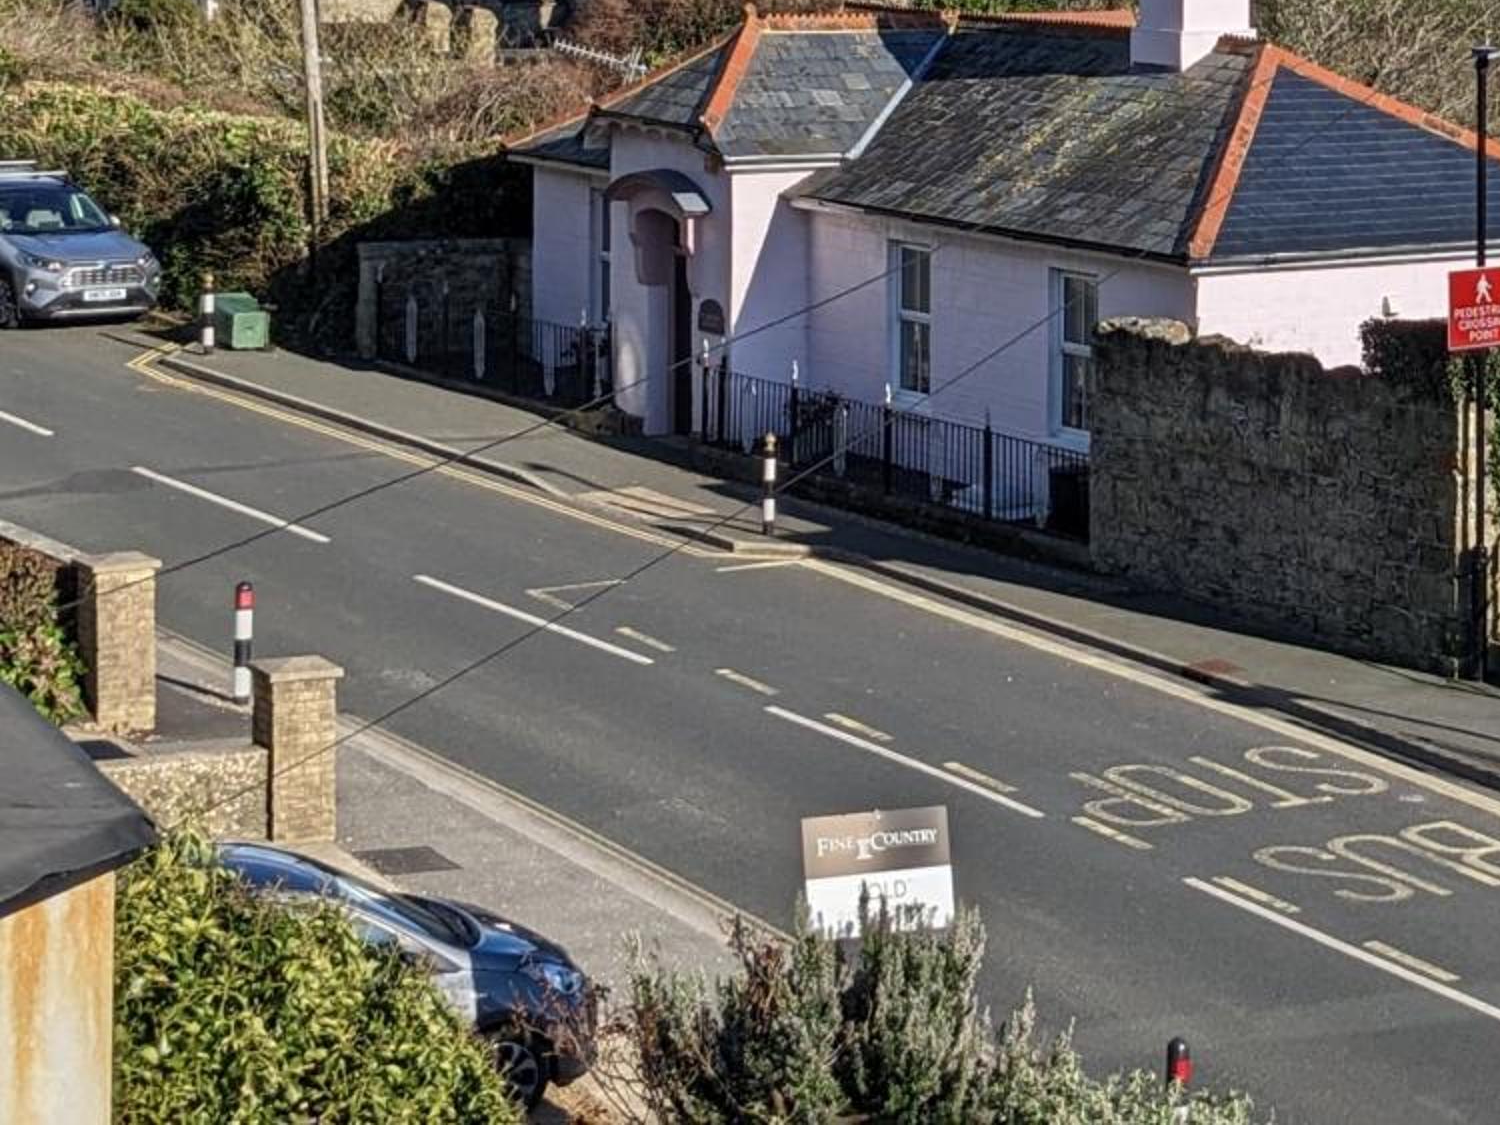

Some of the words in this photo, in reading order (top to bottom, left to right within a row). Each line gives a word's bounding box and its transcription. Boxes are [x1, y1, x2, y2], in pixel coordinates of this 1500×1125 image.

[1469, 328, 1499, 342] POINT
[1069, 746, 1389, 827] STOP
[871, 828, 937, 851] COUNTRY
